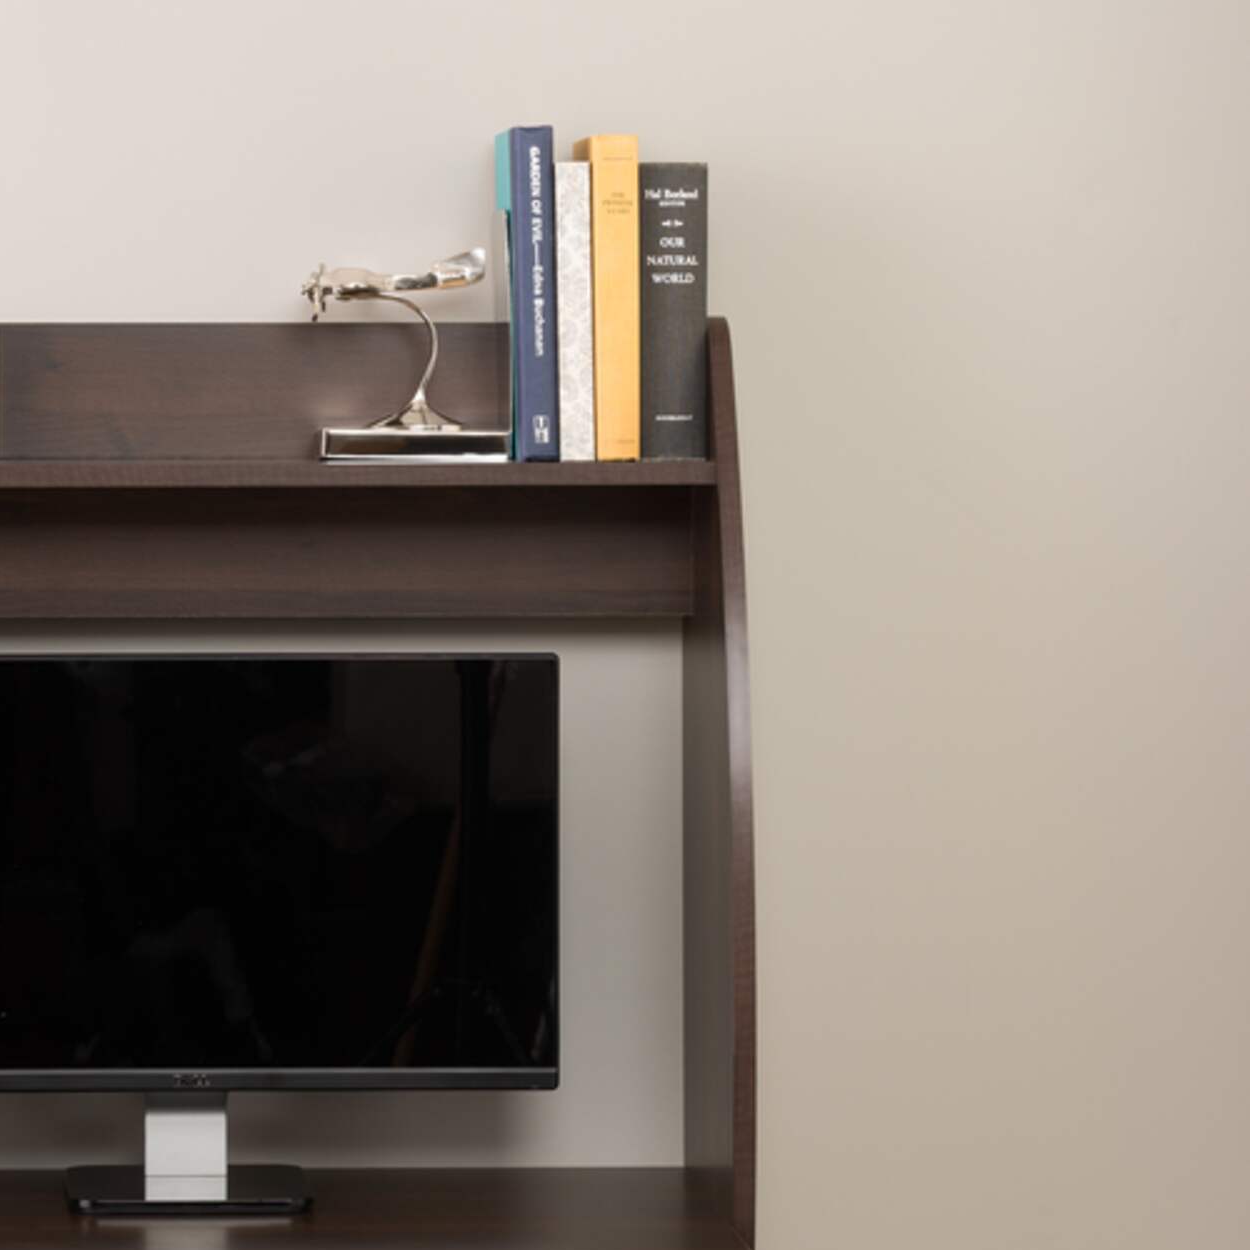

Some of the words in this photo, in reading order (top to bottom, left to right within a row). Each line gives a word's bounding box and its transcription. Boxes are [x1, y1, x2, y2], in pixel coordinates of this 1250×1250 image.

[529, 145, 541, 198] GARDEN
[531, 200, 542, 214] OF
[659, 236, 685, 249] OUR
[647, 254, 699, 267] NATURAL
[651, 271, 695, 285] WORLD
